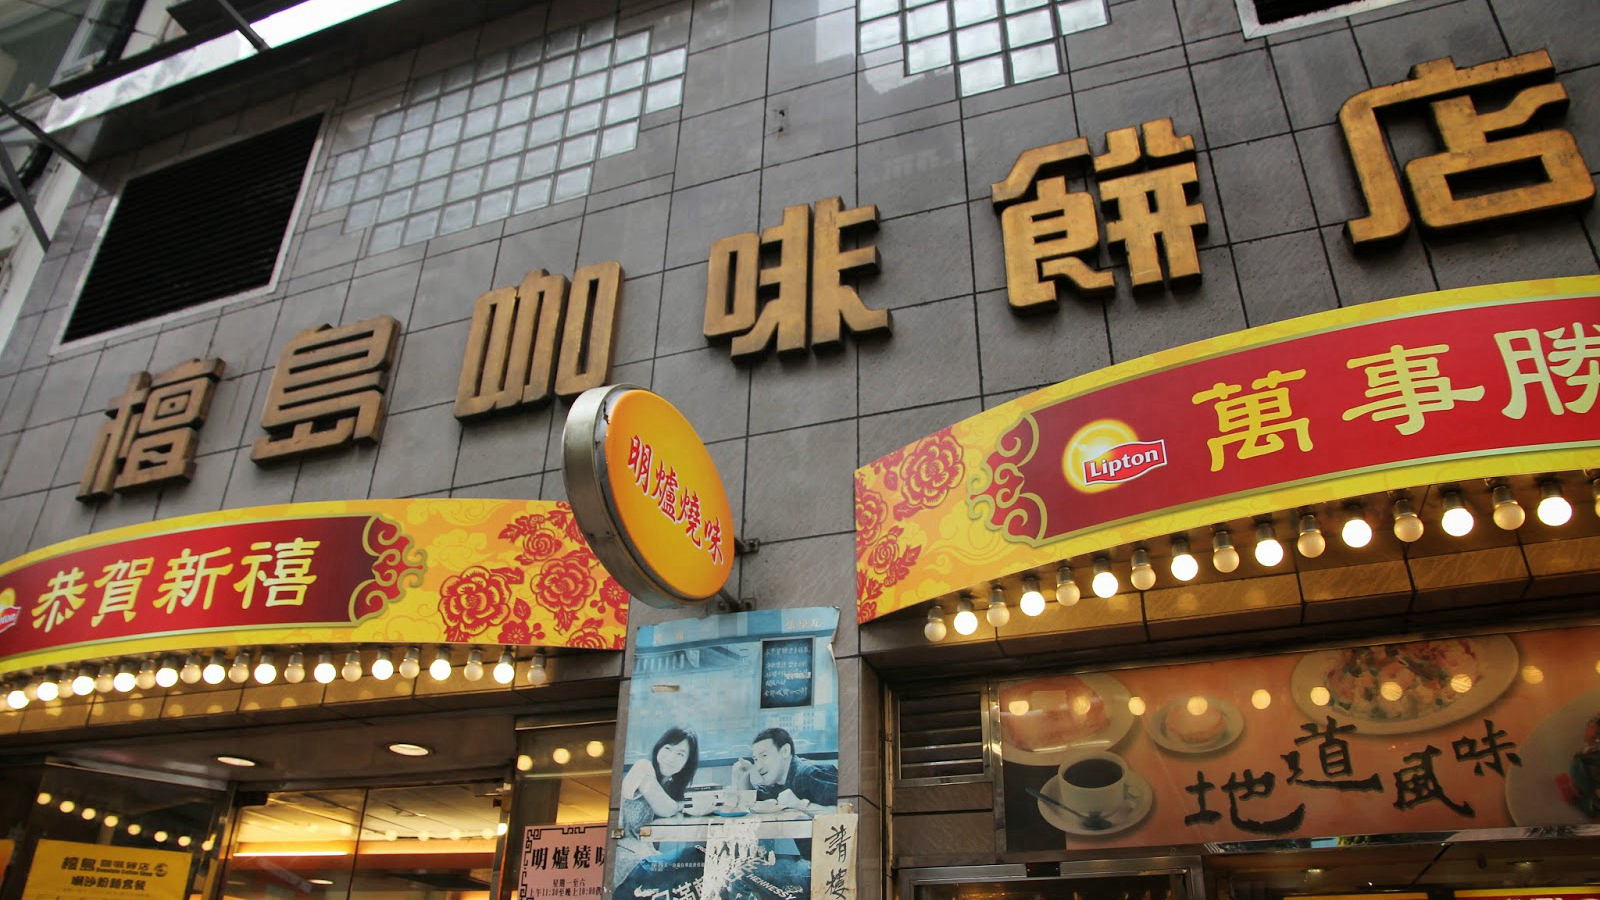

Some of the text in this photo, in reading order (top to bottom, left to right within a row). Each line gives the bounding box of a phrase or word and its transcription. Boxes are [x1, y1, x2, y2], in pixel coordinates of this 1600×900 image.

[76, 50, 1596, 502] 檀島咖啡餅店
[627, 435, 724, 565] 明爐燒味
[1090, 449, 1159, 478] Lipton
[31, 537, 321, 633] 恭賀新禧
[1184, 715, 1523, 836] 地道風味
